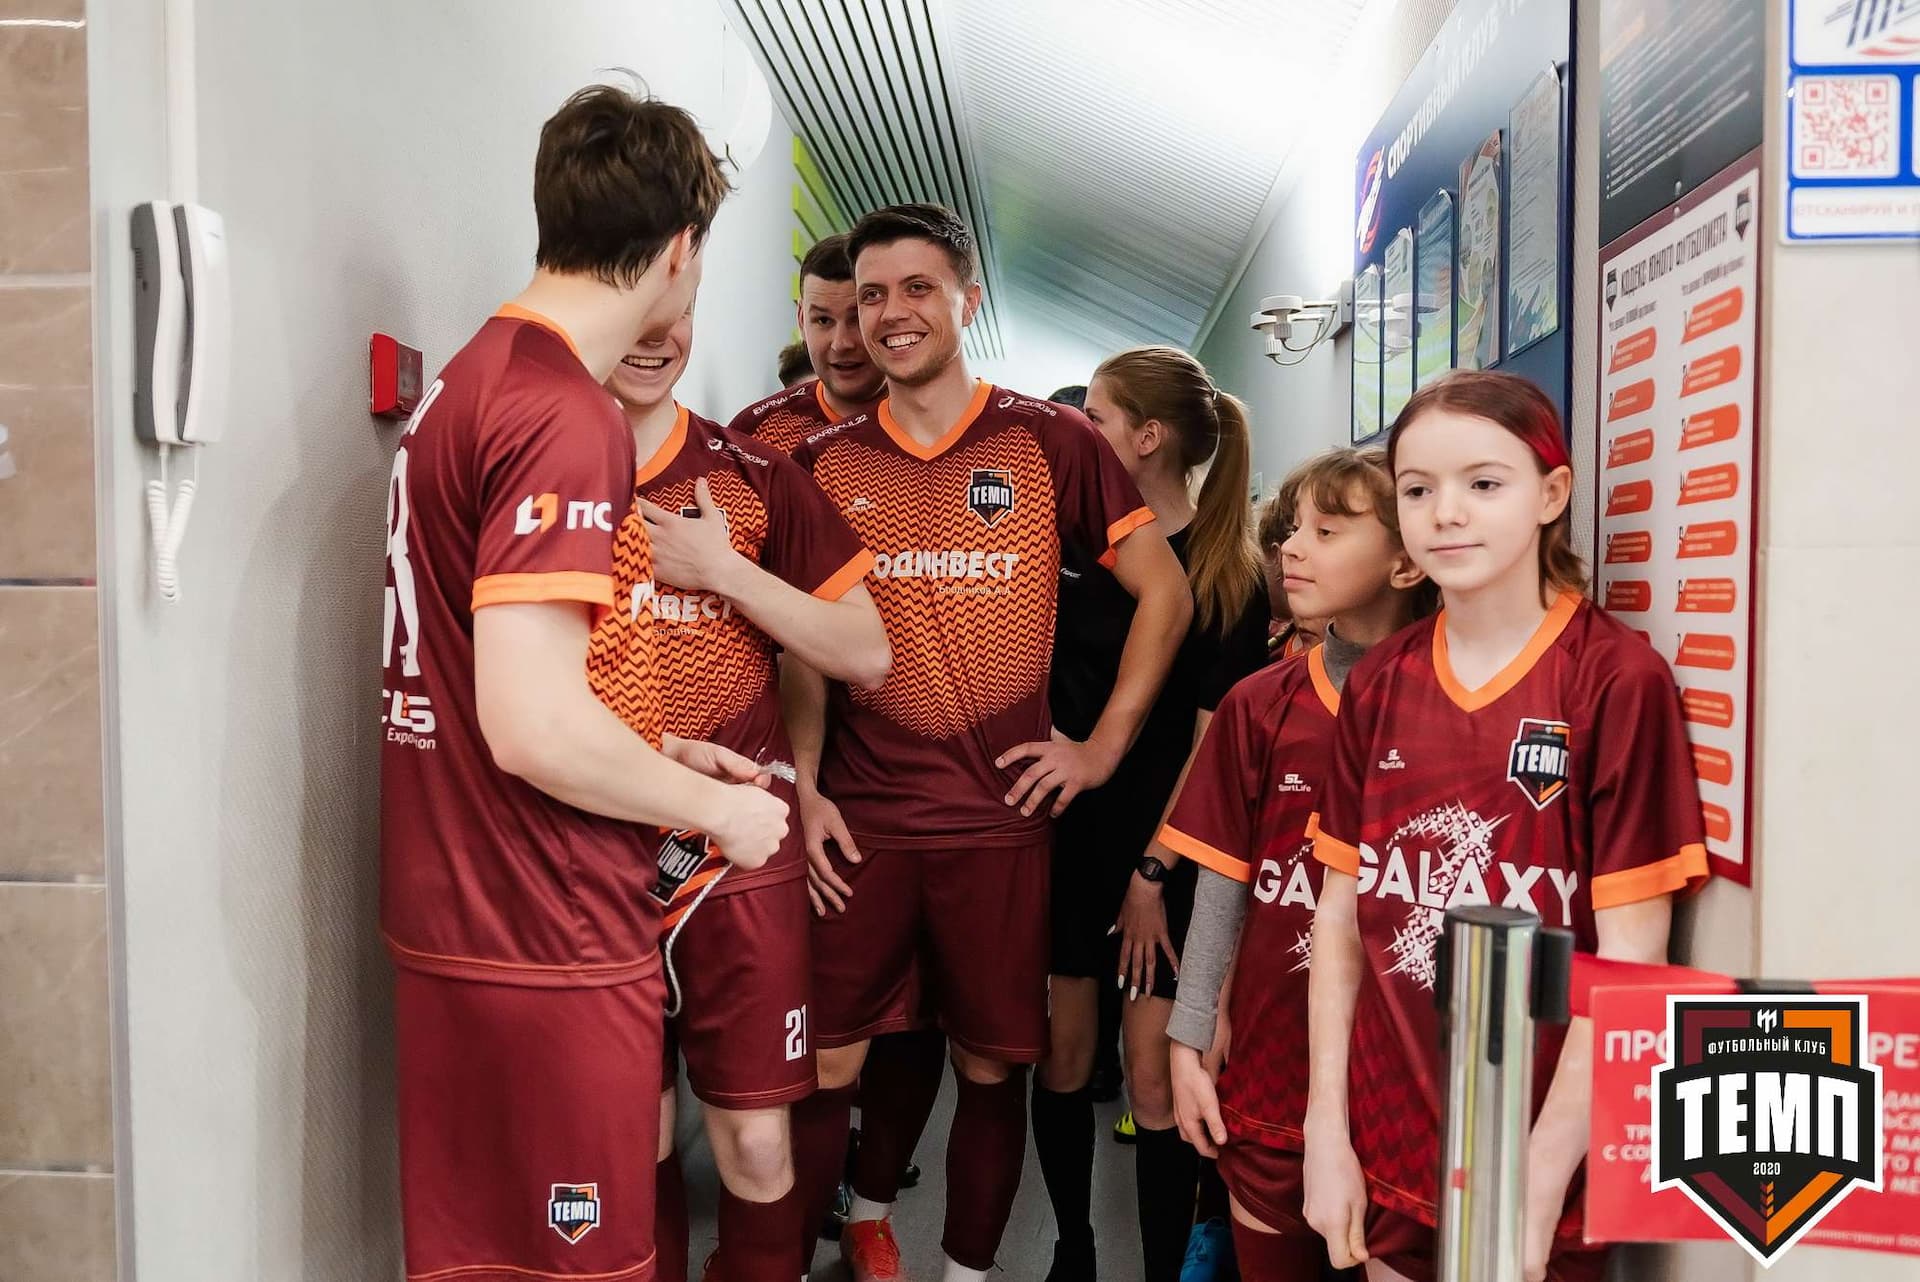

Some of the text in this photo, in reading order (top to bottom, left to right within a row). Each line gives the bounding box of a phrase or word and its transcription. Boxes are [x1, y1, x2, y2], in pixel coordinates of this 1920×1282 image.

[972, 485, 1010, 507] ТЕМП
[1517, 744, 1569, 778] ТЕМП
[1253, 858, 1328, 911] GA
[1356, 842, 1578, 926] GALAXY
[785, 1003, 807, 1061] 21
[553, 1200, 595, 1222] ТЕМП
